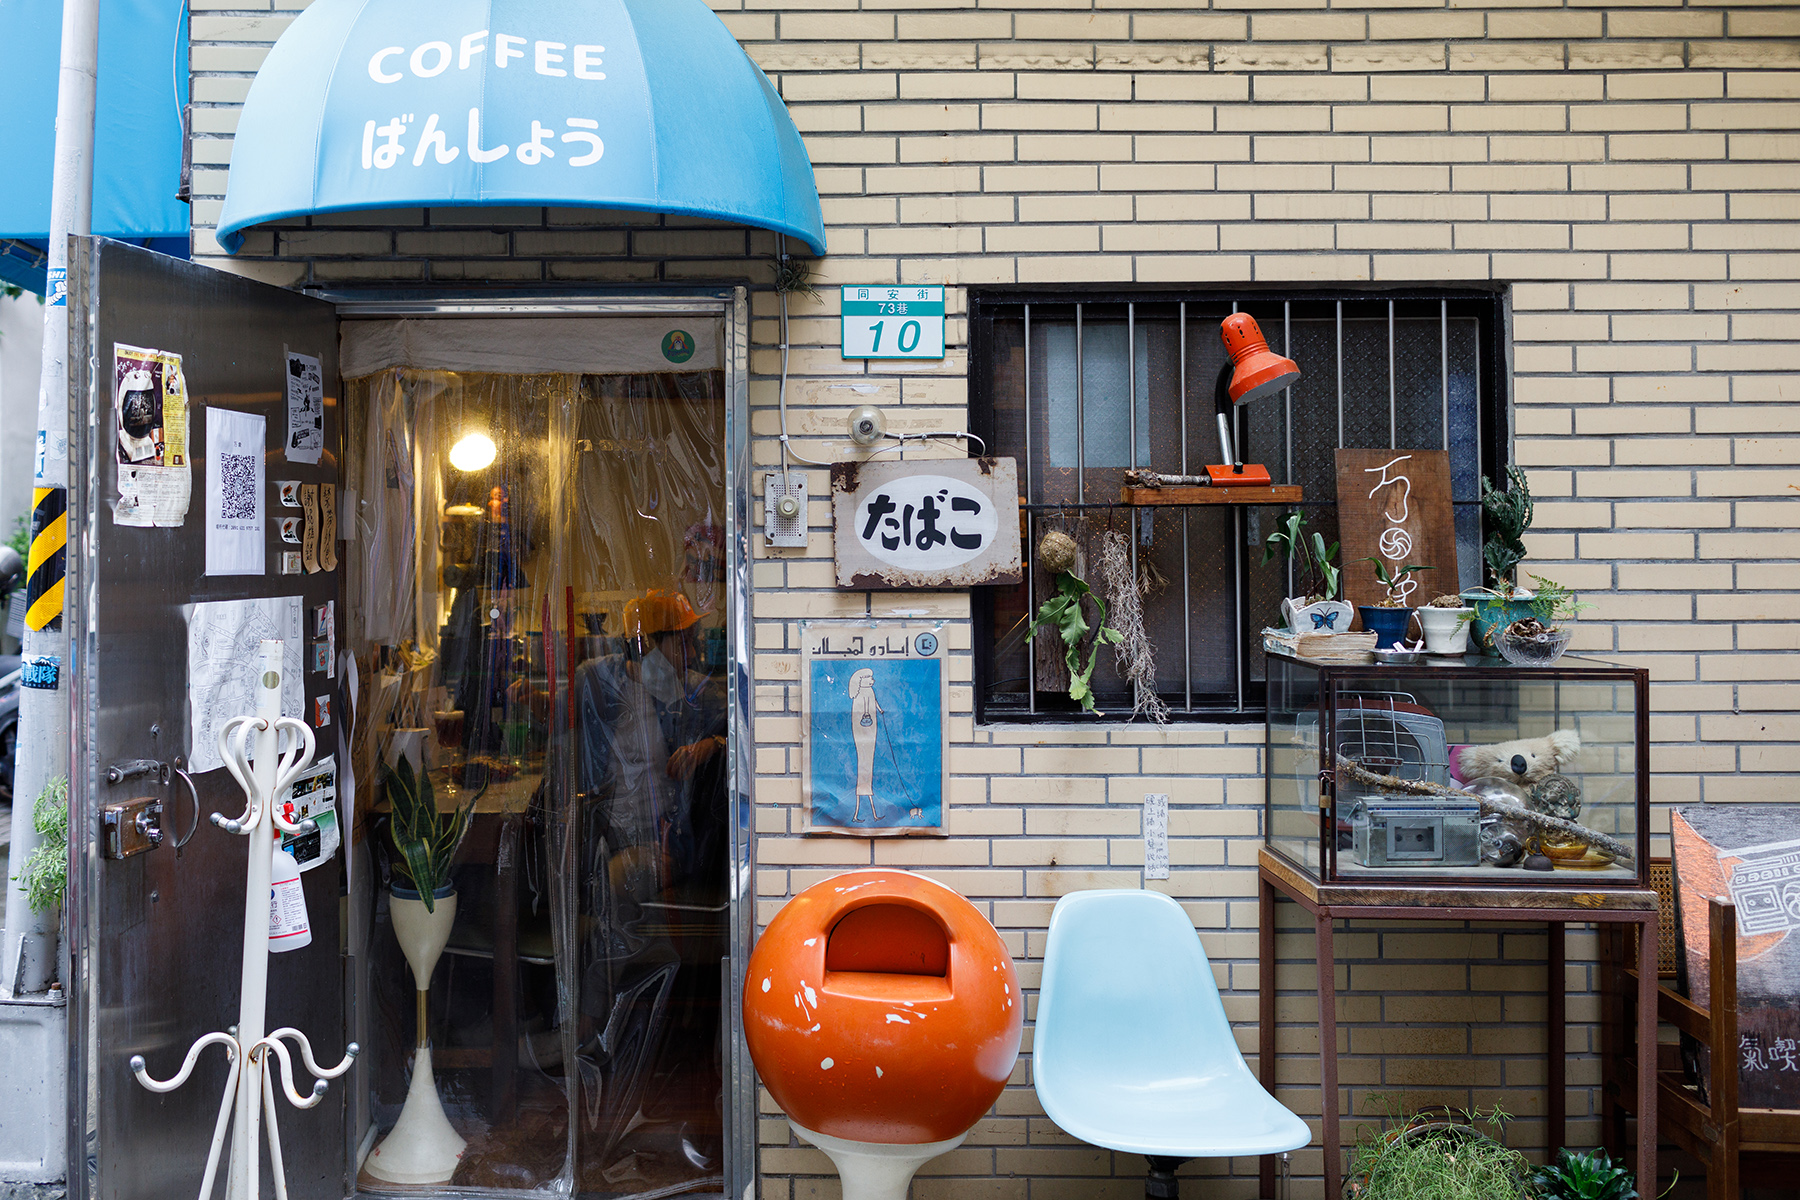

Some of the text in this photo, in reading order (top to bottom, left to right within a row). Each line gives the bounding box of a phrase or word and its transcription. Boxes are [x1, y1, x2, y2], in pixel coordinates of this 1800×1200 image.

[367, 29, 607, 84] COFFEE
[361, 106, 605, 170] ばんしょう
[857, 288, 929, 301] 同安街
[878, 302, 909, 315] 73巷
[869, 319, 921, 353] 10
[861, 488, 983, 551] たばこ
